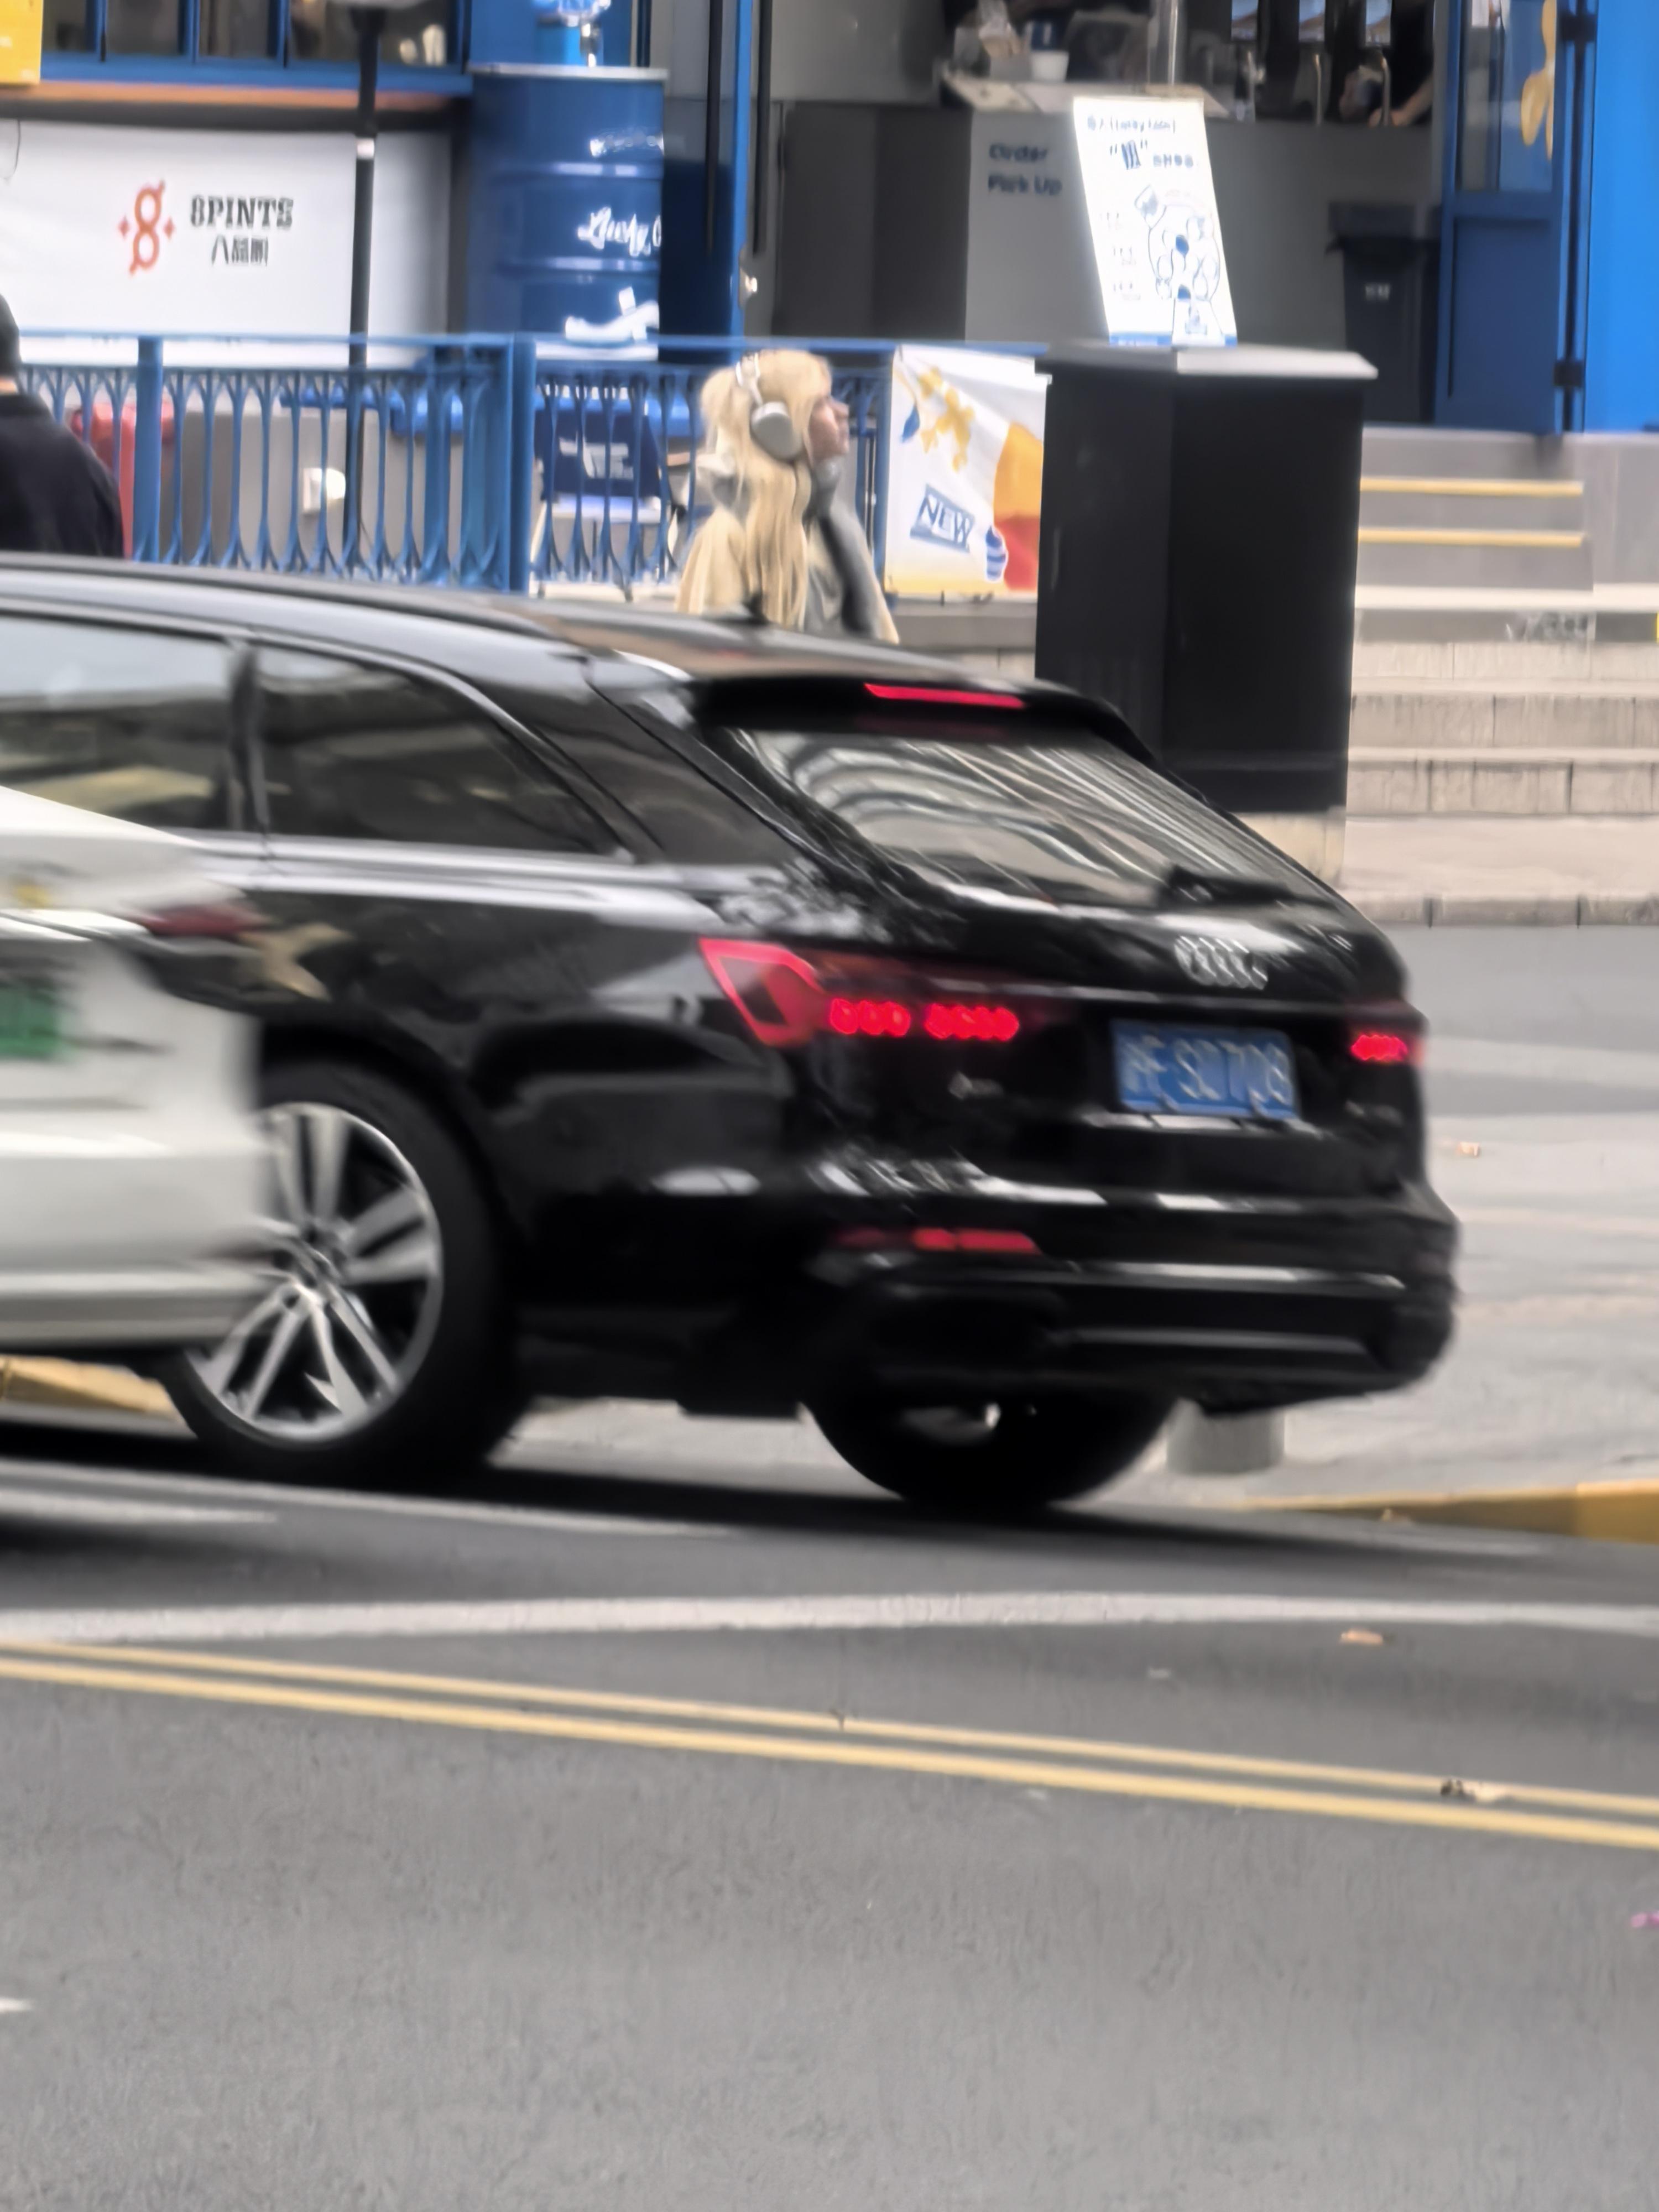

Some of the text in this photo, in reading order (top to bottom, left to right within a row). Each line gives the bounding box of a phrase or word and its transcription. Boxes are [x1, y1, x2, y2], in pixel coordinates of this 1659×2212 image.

[989, 143, 1047, 163] Order
[987, 174, 1062, 196] Pick Up
[190, 194, 294, 229] 8PINTS
[916, 491, 974, 549] NEW
